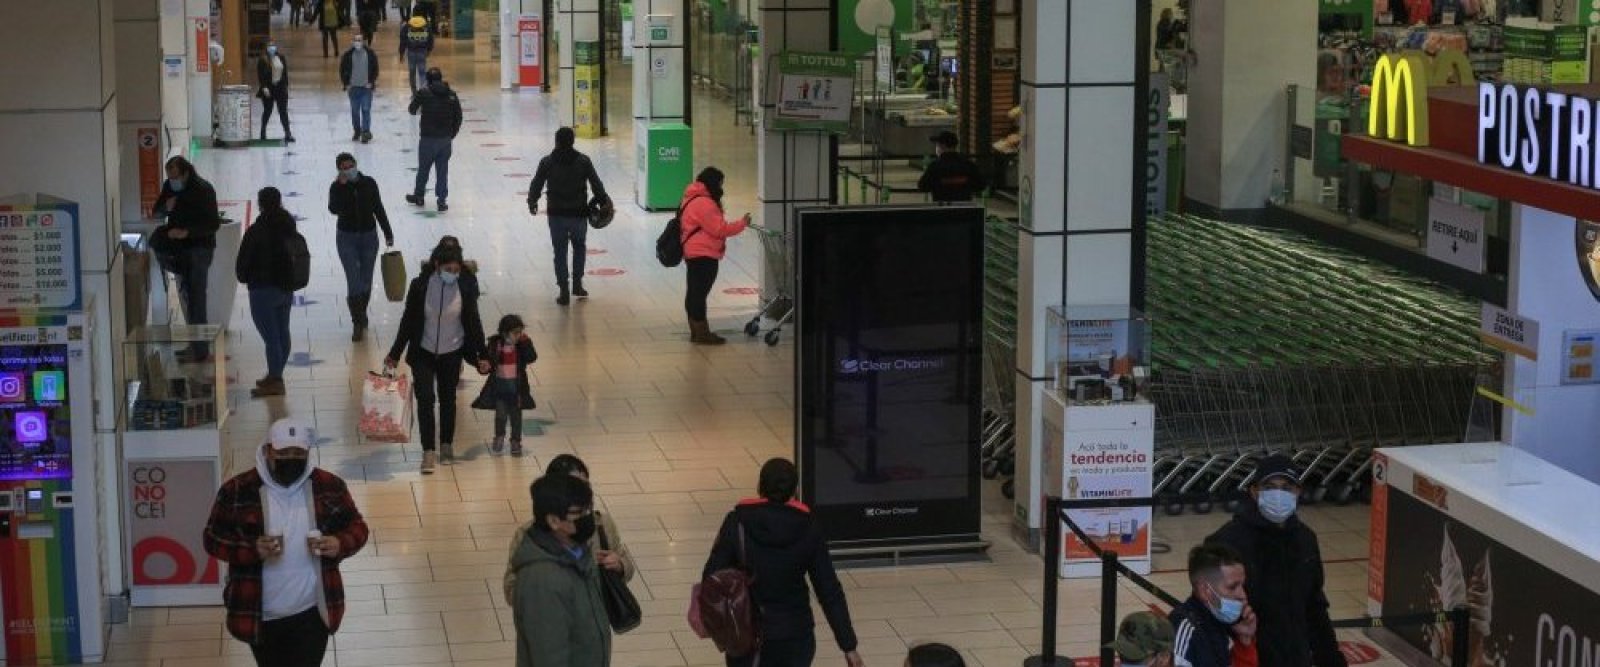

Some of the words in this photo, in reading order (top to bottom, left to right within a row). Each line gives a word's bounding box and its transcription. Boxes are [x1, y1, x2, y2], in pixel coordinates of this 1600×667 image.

[801, 55, 846, 67] TOTTUS
[1477, 81, 1600, 190] POSTR
[1431, 219, 1458, 238] RETIRE
[1458, 227, 1478, 244] AQUÍ
[1495, 312, 1514, 328] ZONA
[1515, 319, 1524, 331] DE
[1494, 321, 1524, 343] ENTREGA
[860, 360, 892, 370] Clear
[894, 358, 944, 369] Channel
[1071, 450, 1147, 465] tendencia
[133, 466, 166, 484] CO
[134, 484, 166, 501] NO
